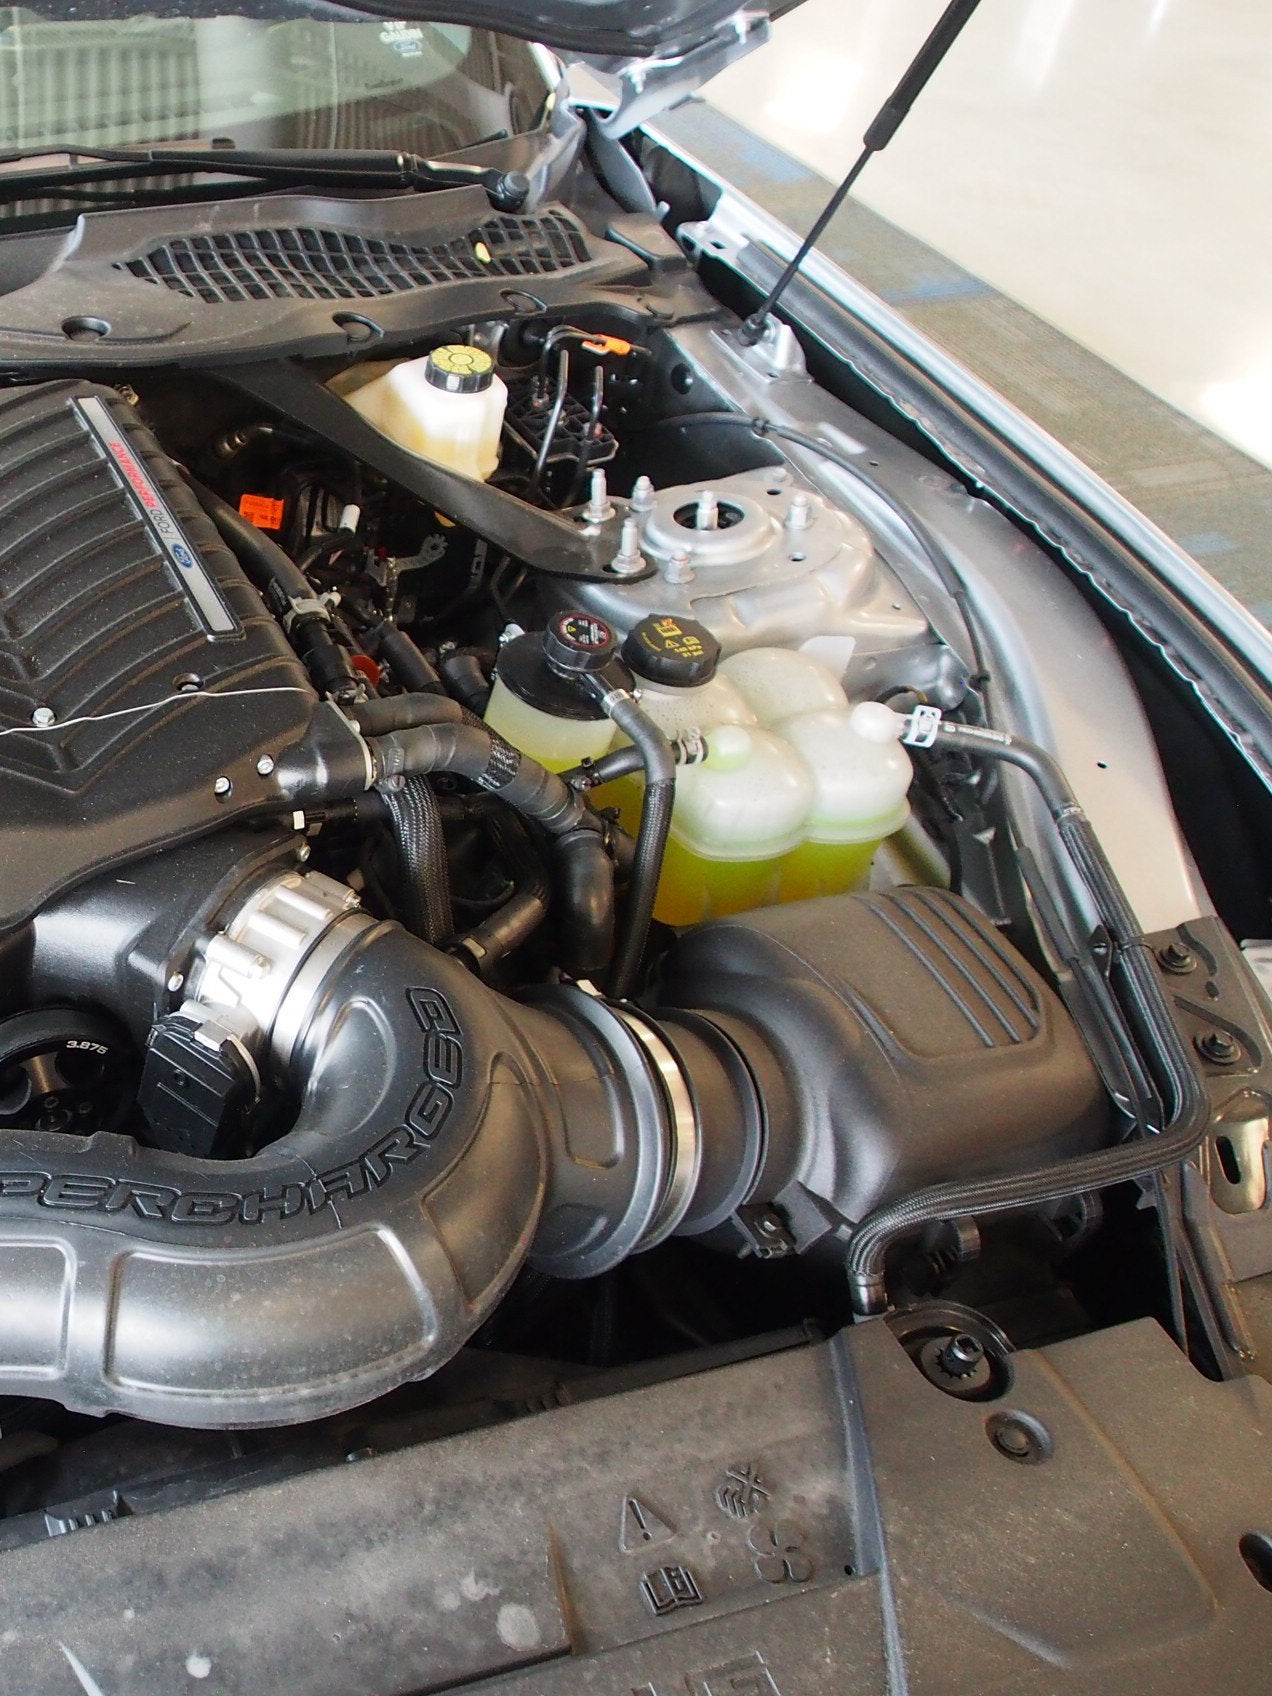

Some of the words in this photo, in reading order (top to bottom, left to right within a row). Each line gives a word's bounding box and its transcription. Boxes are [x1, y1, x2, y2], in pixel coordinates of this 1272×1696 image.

[109, 442, 157, 508] PERFORMANCE
[150, 508, 174, 534] FORD
[66, 1040, 109, 1055] 3.875
